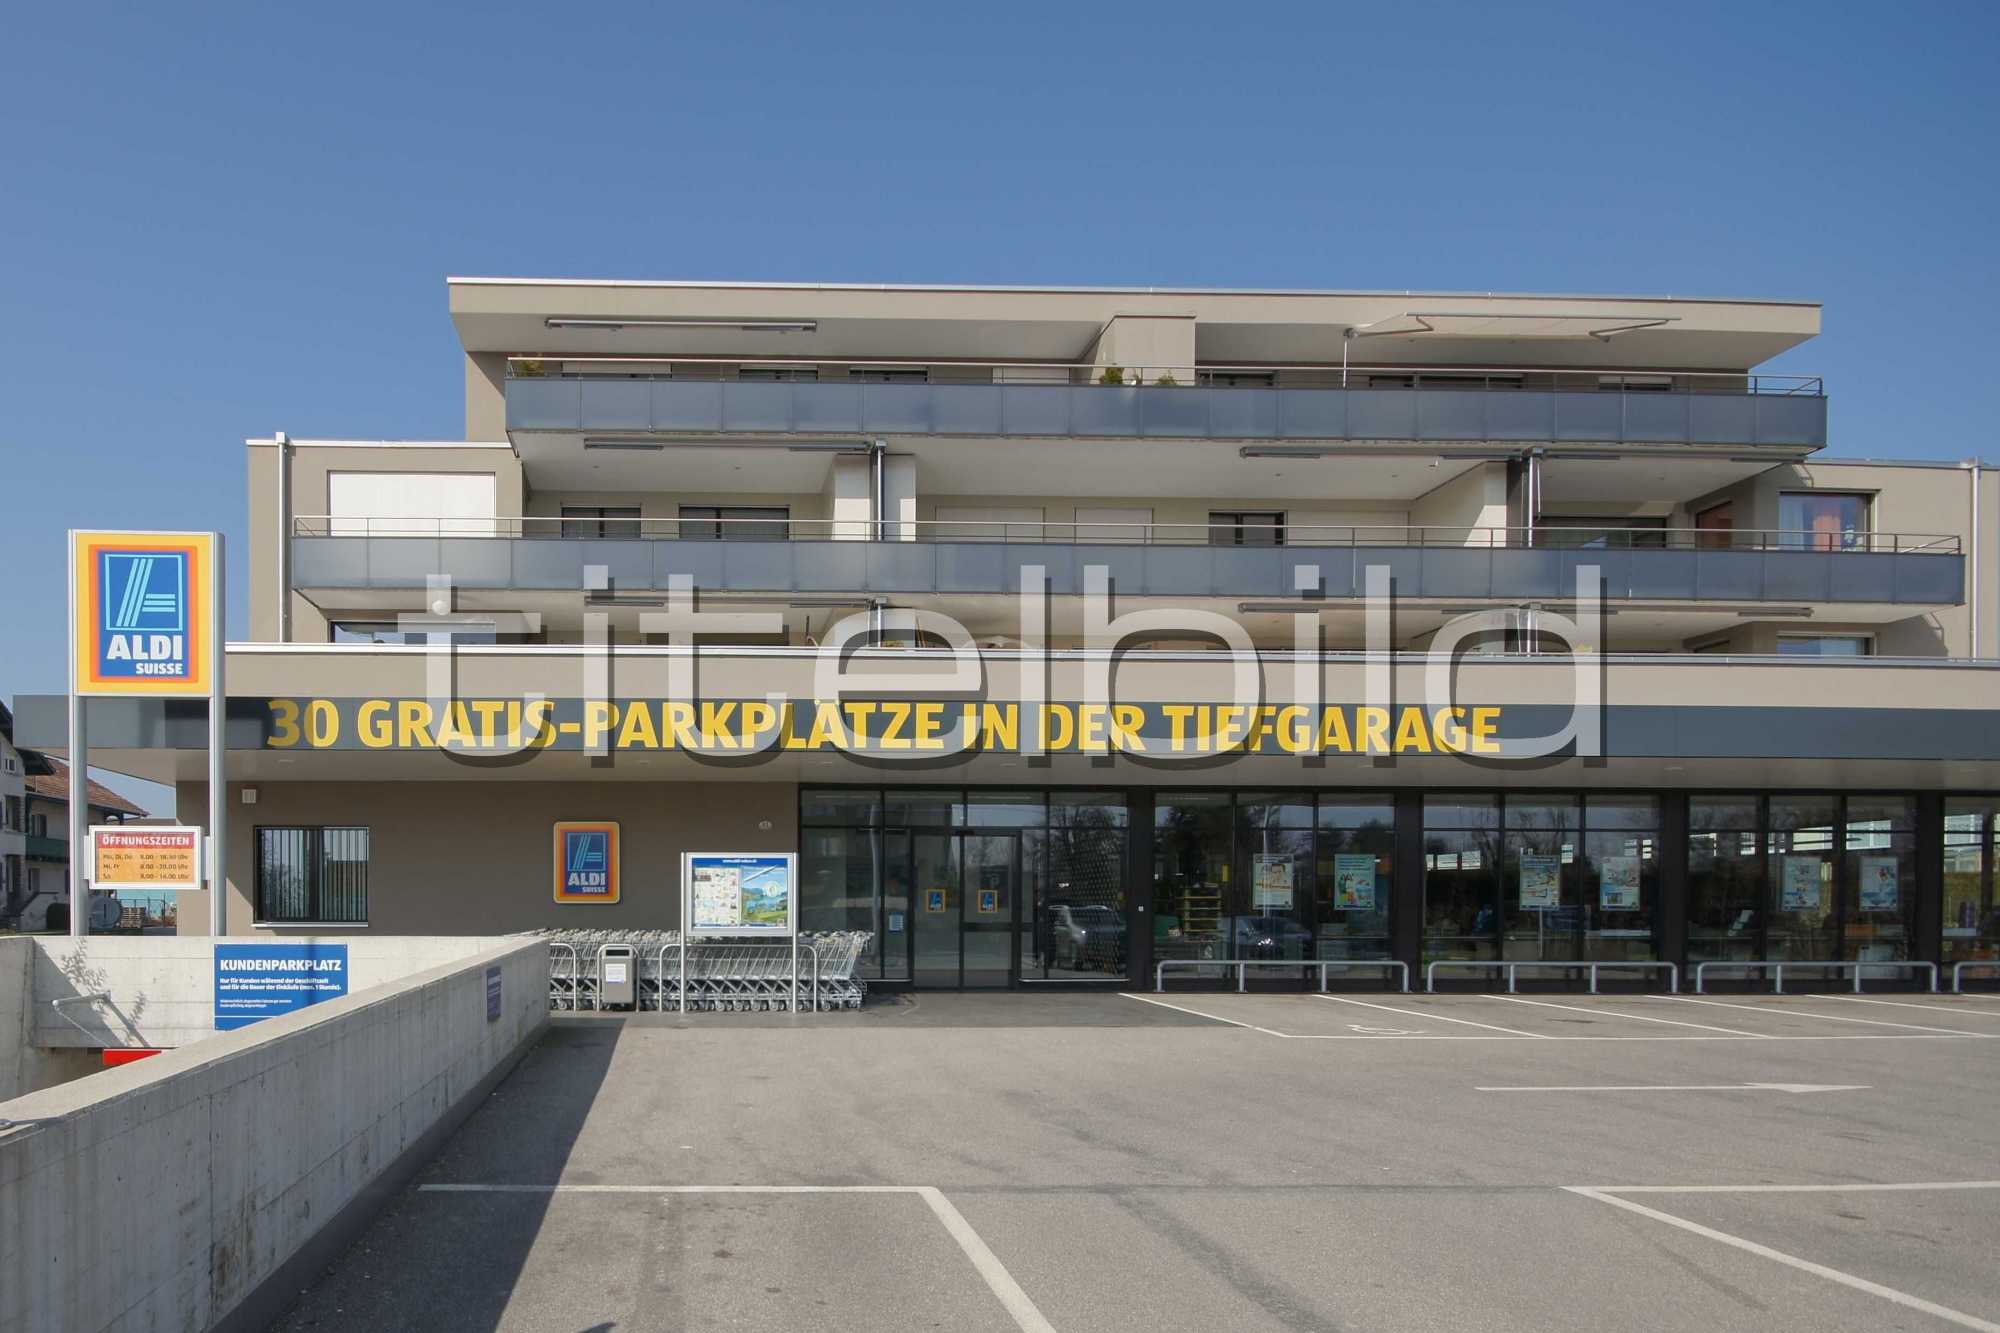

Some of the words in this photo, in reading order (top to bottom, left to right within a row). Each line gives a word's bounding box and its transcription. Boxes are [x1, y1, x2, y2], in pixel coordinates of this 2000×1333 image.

[106, 634, 183, 660] ALDI
[136, 663, 183, 675] SUISSE
[267, 698, 340, 749] 30
[963, 702, 1019, 750] IN
[1038, 703, 1146, 751] DER
[1162, 704, 1503, 753] TIEFGARAGE
[102, 833, 190, 846] ÖFFNUNGSZEITEN
[568, 872, 606, 886] ALDI
[220, 959, 342, 971] KUNDENPARKPLATZ
